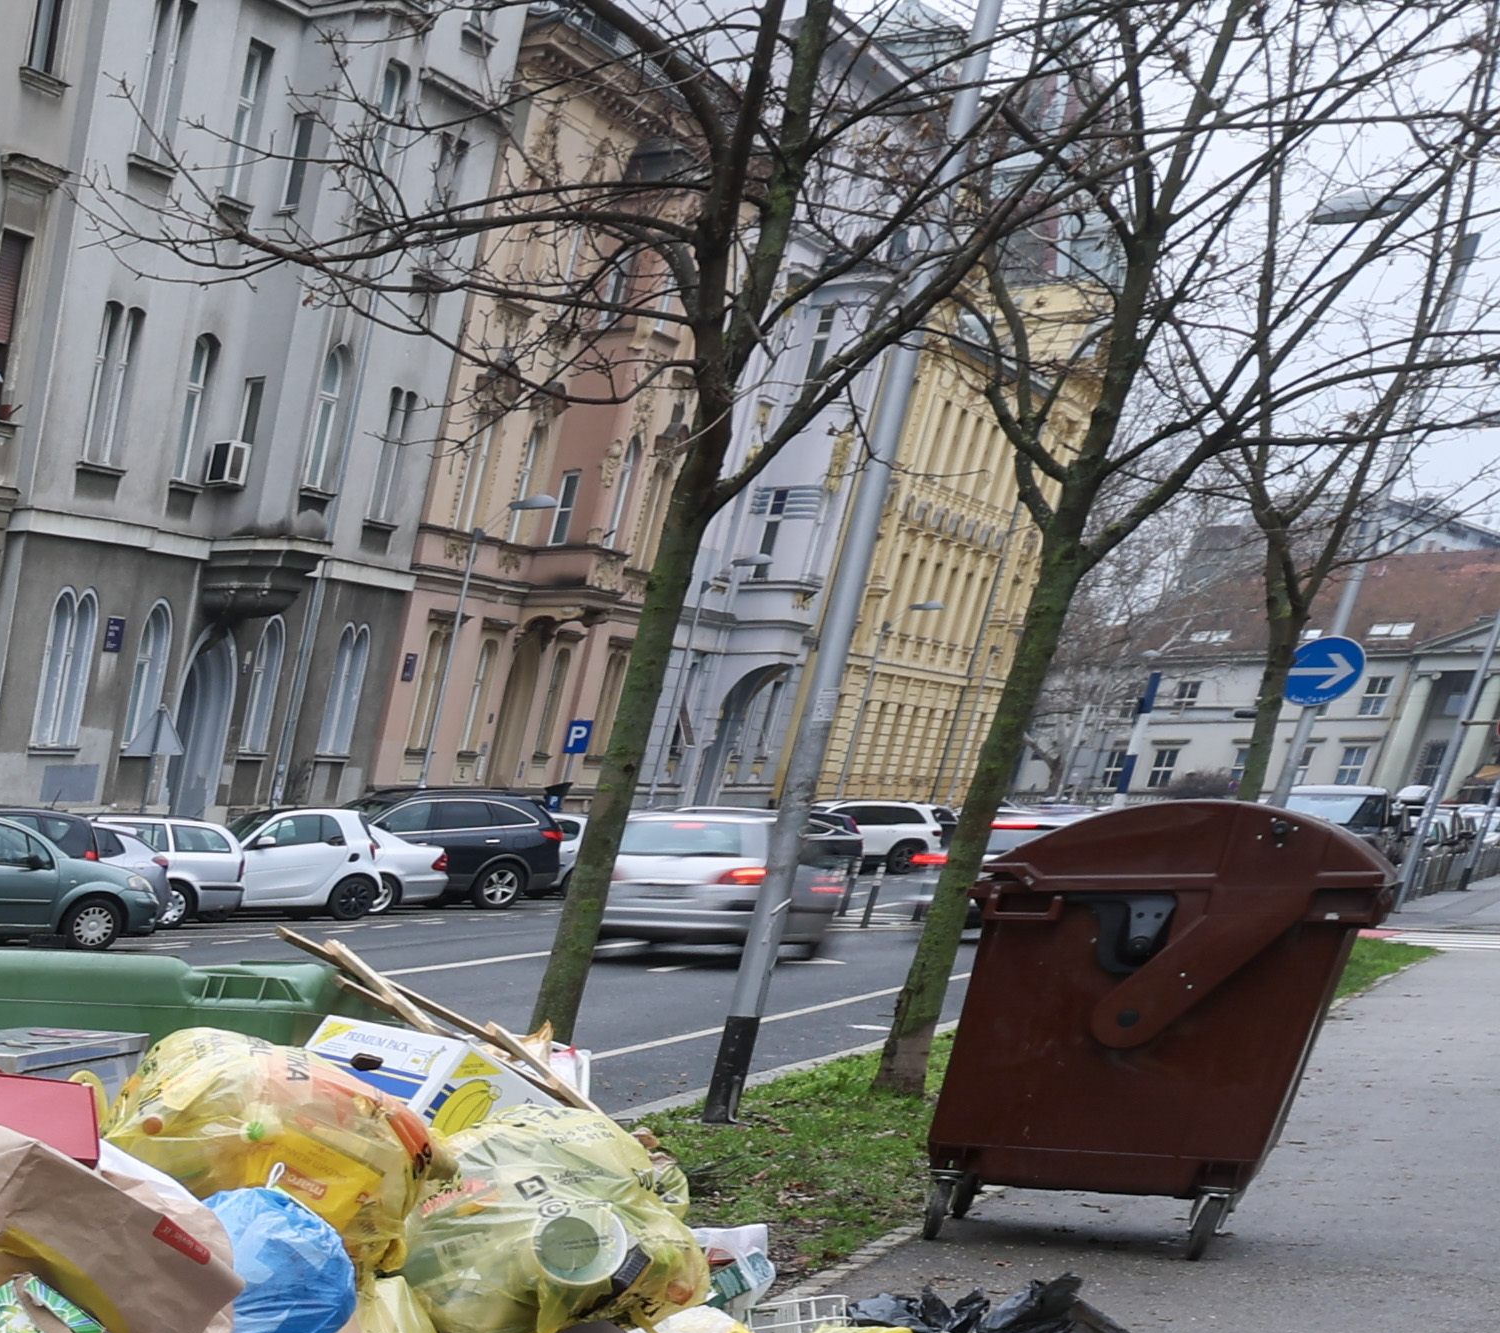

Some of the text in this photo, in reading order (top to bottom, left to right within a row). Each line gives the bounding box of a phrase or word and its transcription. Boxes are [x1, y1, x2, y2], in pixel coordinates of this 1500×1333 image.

[568, 724, 587, 750] P
[343, 1028, 414, 1053] PREMIUM PACK
